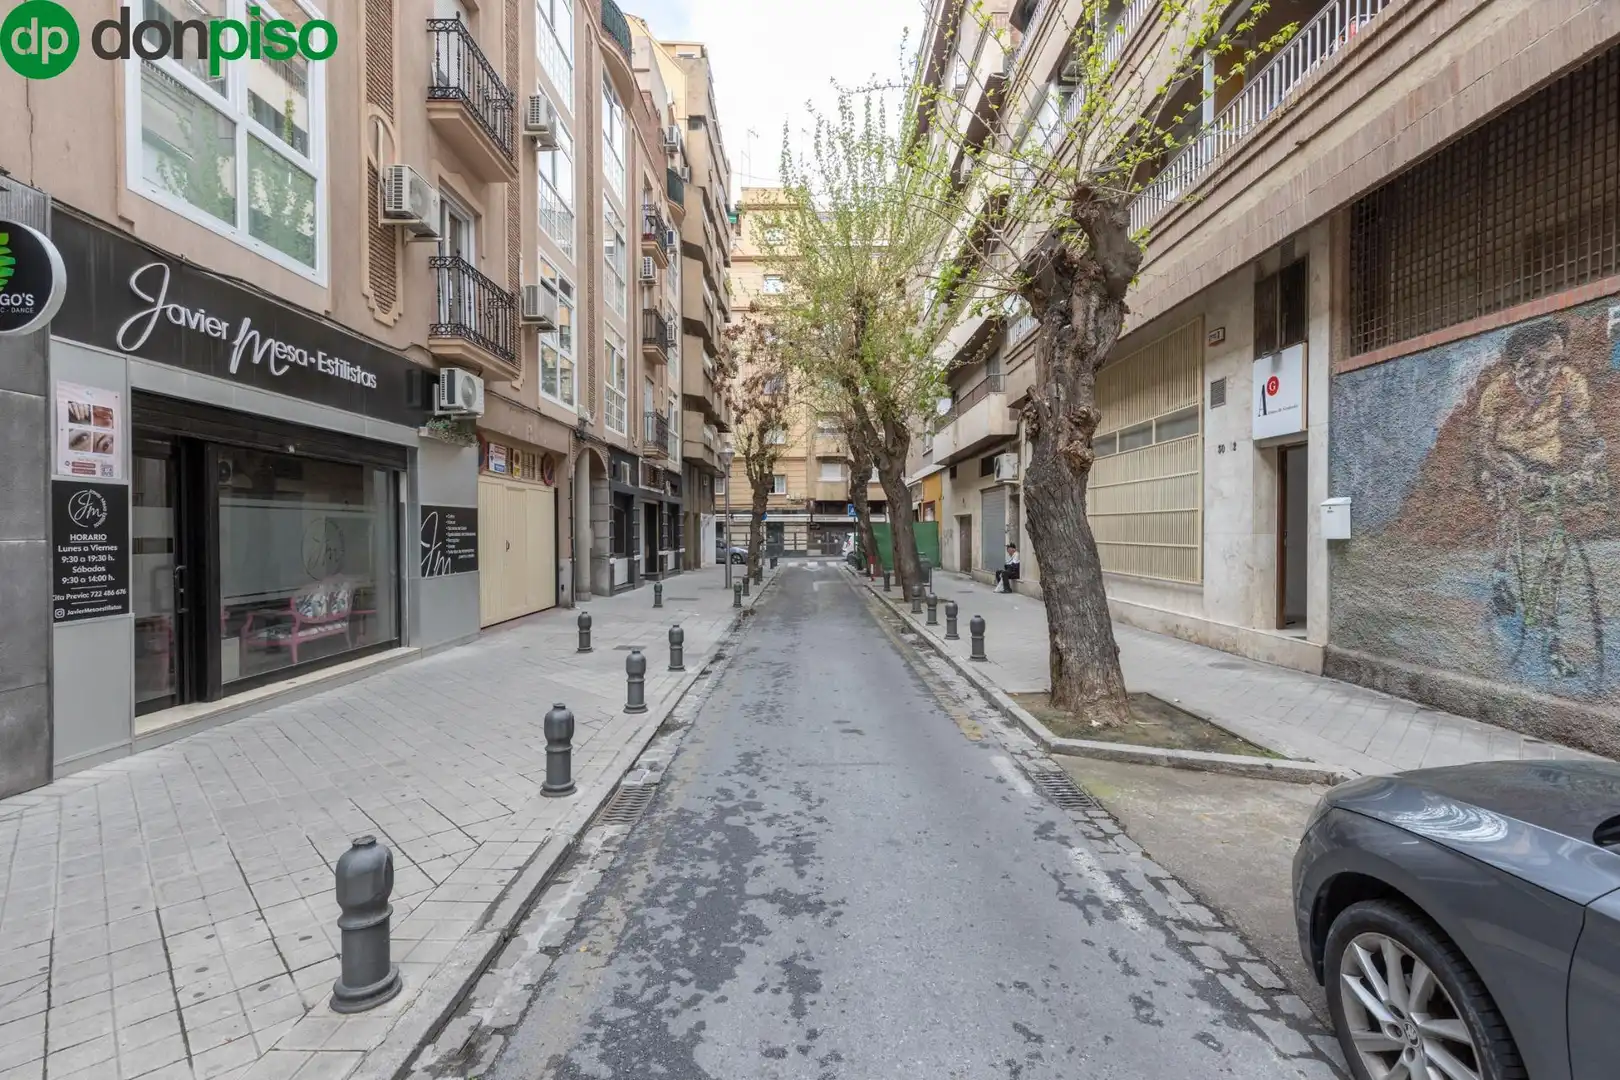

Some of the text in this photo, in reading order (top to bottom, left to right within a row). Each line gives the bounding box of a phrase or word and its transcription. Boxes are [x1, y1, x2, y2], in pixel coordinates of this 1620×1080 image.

[116, 262, 377, 389] Javier Mesa Estilistas
[1269, 381, 1276, 391] G
[70, 533, 107, 541] HORARIO
[58, 545, 82, 553] Lunes
[72, 565, 106, 573] Sábados
[61, 576, 79, 584] 9:30
